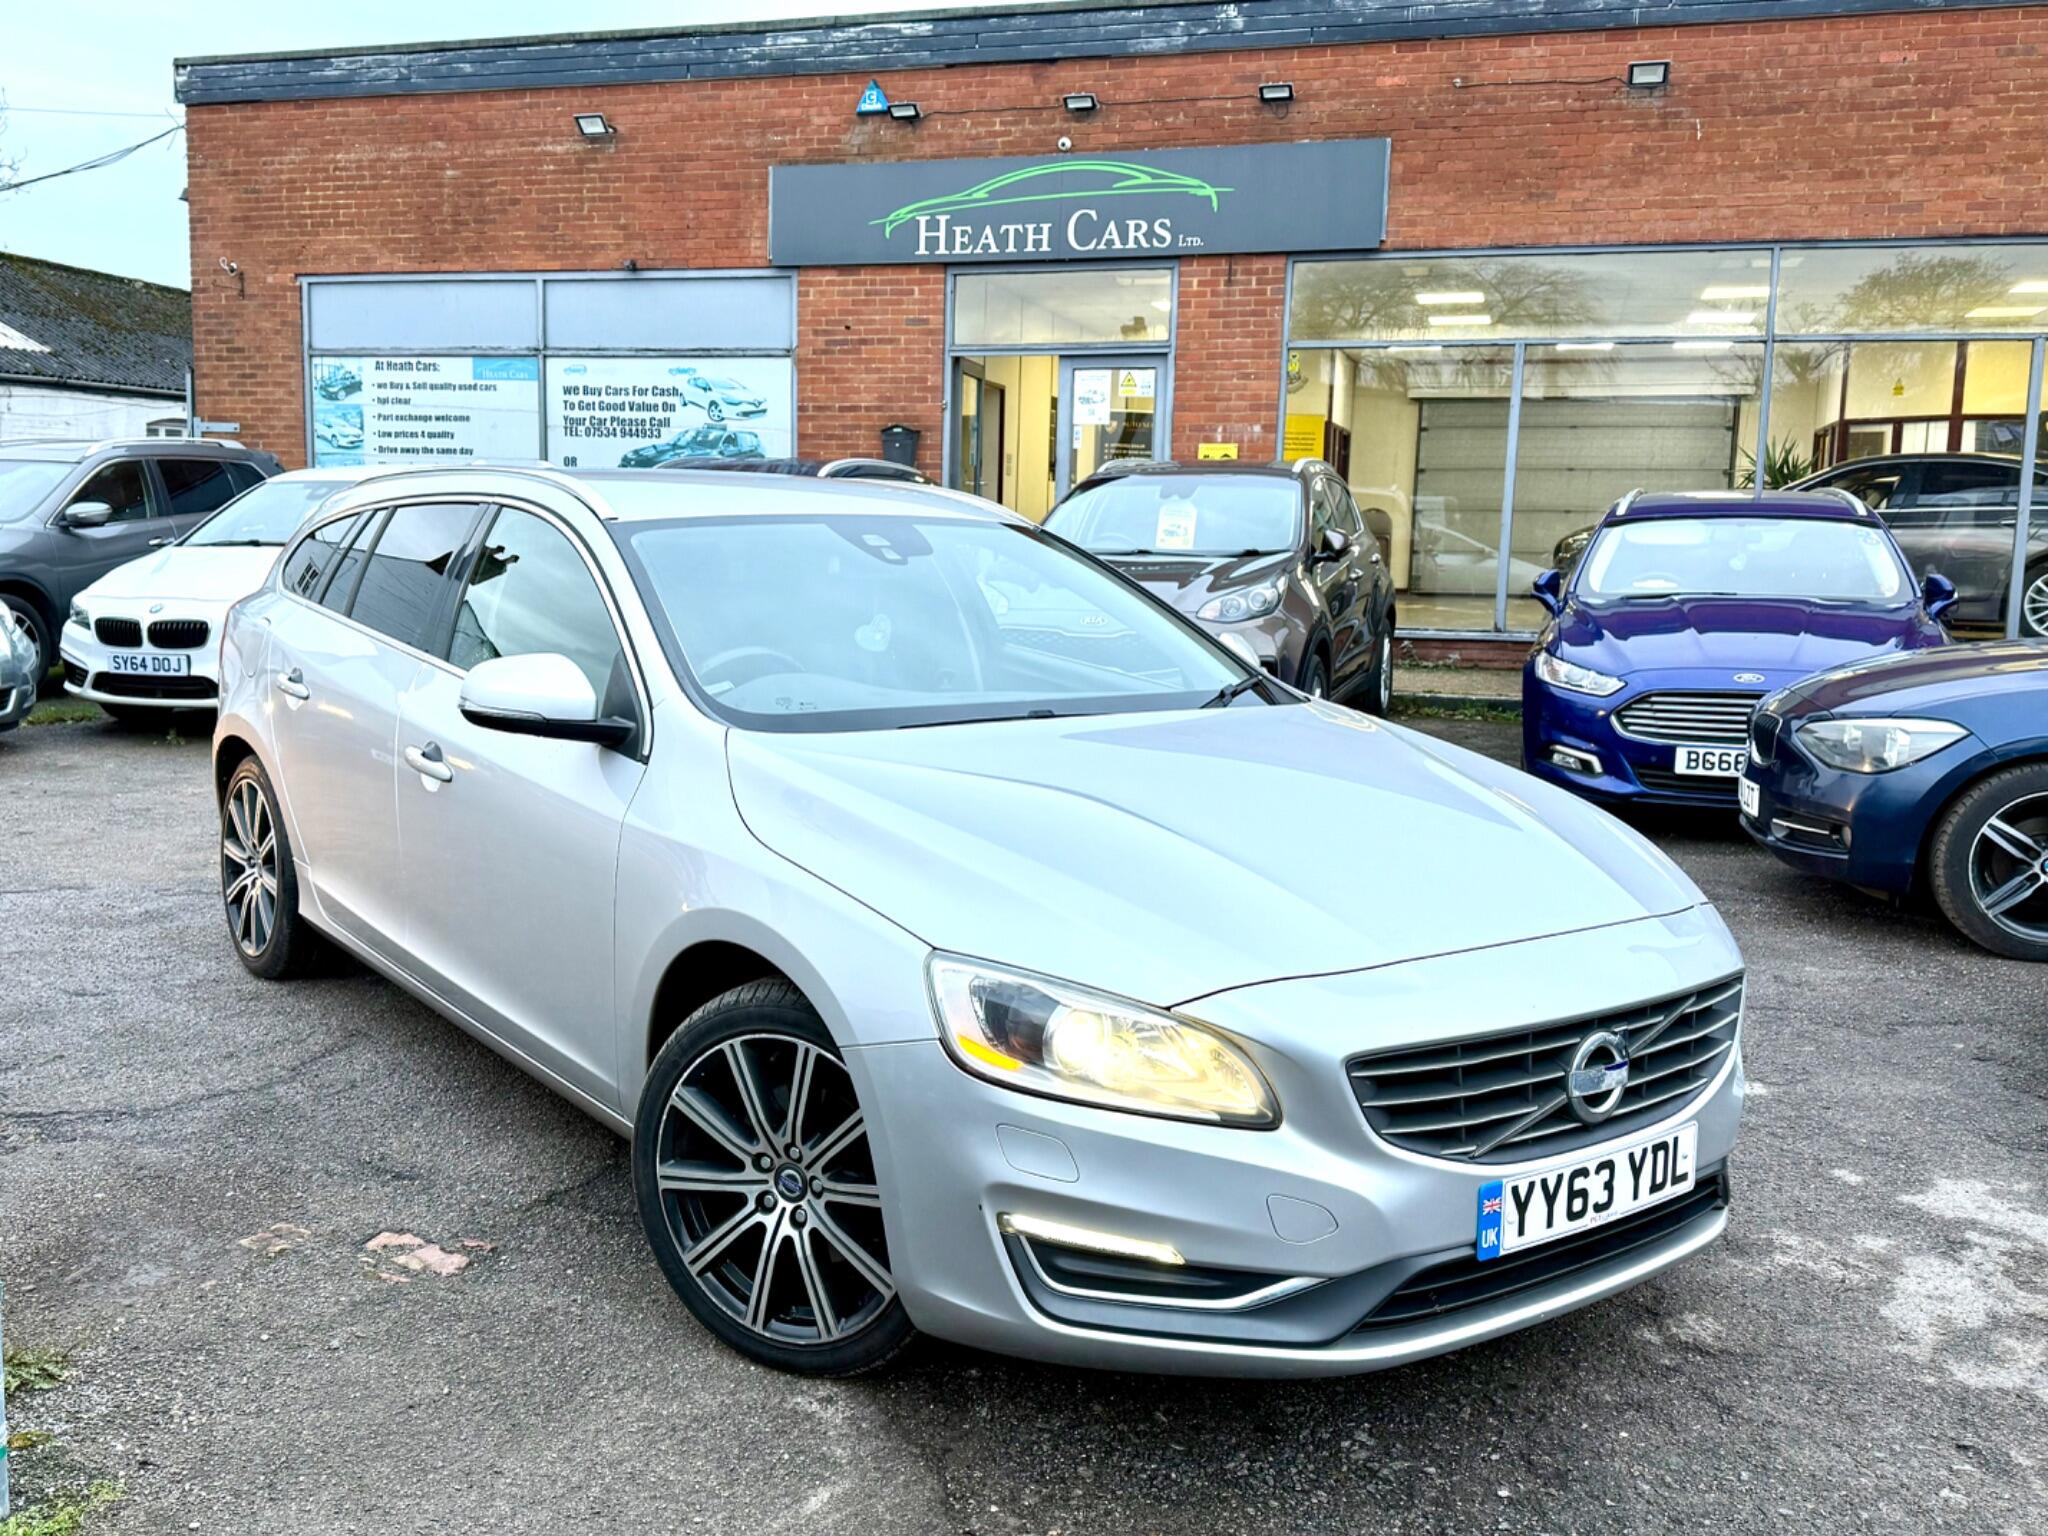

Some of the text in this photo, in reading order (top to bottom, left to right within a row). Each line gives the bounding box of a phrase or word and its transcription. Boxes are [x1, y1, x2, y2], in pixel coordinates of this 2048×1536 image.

[915, 214, 1052, 255] HEATH
[1067, 209, 1172, 251] CARS
[375, 360, 384, 371] At
[386, 360, 414, 372] Heath
[390, 381, 404, 391] Buy
[412, 382, 428, 390] Sell
[429, 382, 456, 392] quality
[458, 382, 478, 391] used
[479, 383, 497, 392] cars
[583, 385, 602, 397] Buy
[605, 385, 630, 397] Cars
[632, 386, 649, 397] For
[391, 396, 411, 405] clear
[563, 400, 676, 413] To Get Good Value On
[377, 412, 470, 422] Part exchange welcome
[563, 415, 671, 428] Your Car Please Call
[378, 430, 392, 438] Low
[394, 430, 419, 439] prices
[427, 430, 454, 440] quality
[563, 426, 662, 439] TEL: 07534 944933
[378, 445, 474, 456] Drive away the same day
[563, 456, 577, 467] OR
[112, 655, 182, 672] SY64 DOJ
[1511, 1136, 1689, 1237] YY63 YDL
[1481, 1227, 1498, 1249] UK
